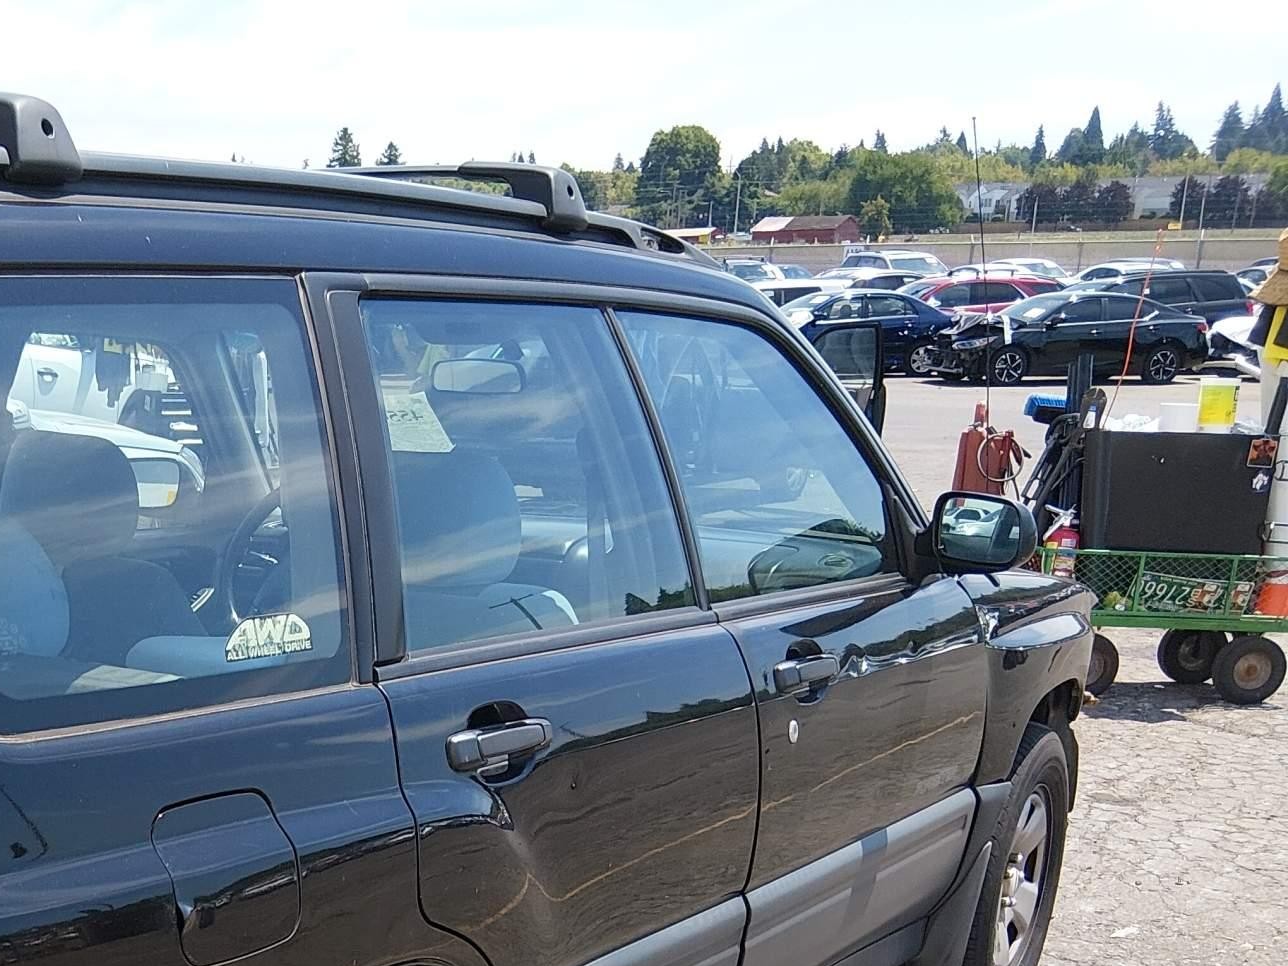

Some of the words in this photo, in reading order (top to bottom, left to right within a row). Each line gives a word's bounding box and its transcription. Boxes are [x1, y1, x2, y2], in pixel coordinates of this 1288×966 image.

[226, 613, 312, 650] AWD
[227, 649, 248, 661] ALL
[249, 643, 282, 658] WHEEL
[284, 639, 312, 653] DRIVE
